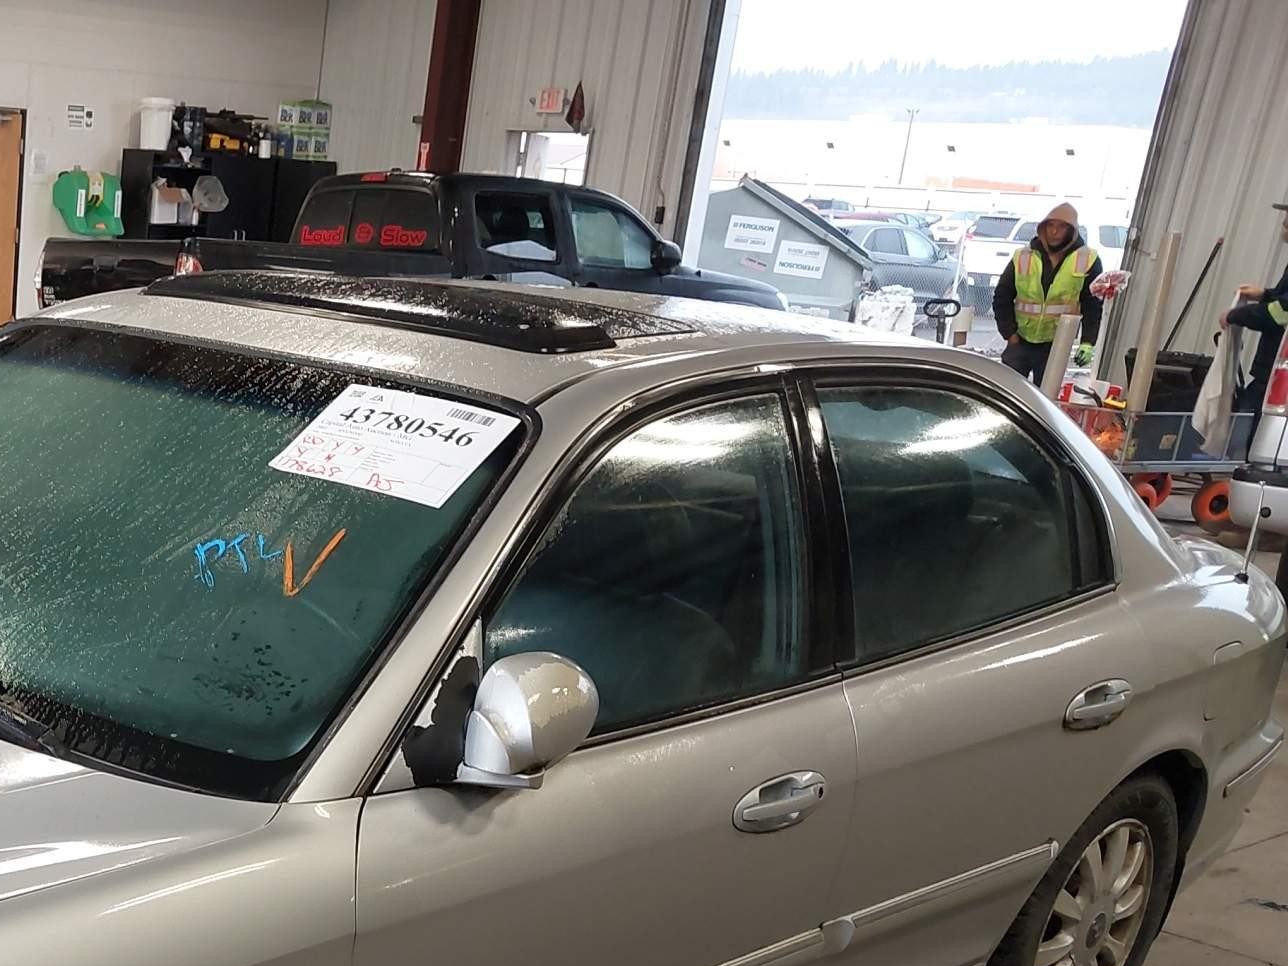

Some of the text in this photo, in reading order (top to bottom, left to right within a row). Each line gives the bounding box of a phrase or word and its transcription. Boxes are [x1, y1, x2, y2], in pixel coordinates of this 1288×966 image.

[539, 90, 561, 110] EXIT
[300, 224, 345, 245] Loud
[380, 225, 427, 246] Slow
[739, 222, 775, 232] FERGUSON
[339, 406, 480, 447] 43780546
